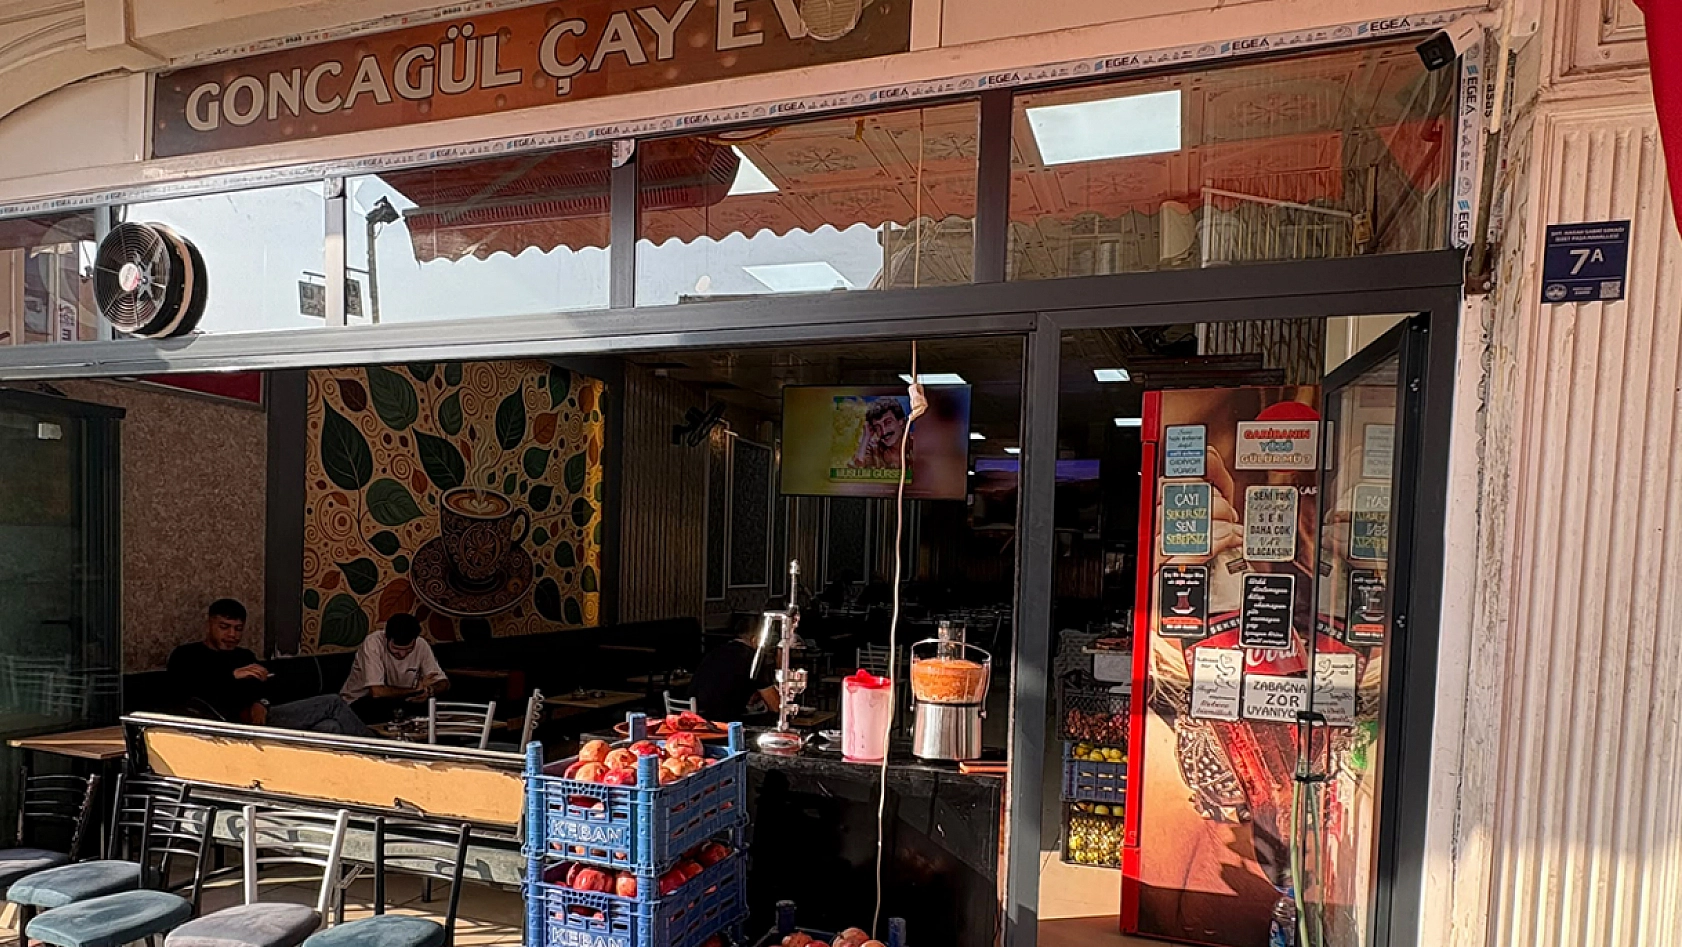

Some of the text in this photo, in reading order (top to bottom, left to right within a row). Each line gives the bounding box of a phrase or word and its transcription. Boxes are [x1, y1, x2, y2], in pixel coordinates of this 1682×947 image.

[1232, 37, 1270, 50] EGEA
[185, 22, 522, 133] GONCAGÜL
[538, 0, 697, 96] ÇAY
[1105, 55, 1139, 68] EGEA
[988, 73, 1021, 84] EGEA
[879, 87, 910, 99] EGEA
[1465, 76, 1479, 115] EGEA
[777, 101, 806, 113] EGEA
[683, 115, 711, 125] EGEA
[1174, 493, 1200, 508] ÇAYI
[1266, 693, 1299, 707] ZOR
[550, 819, 628, 845] KEBAN
